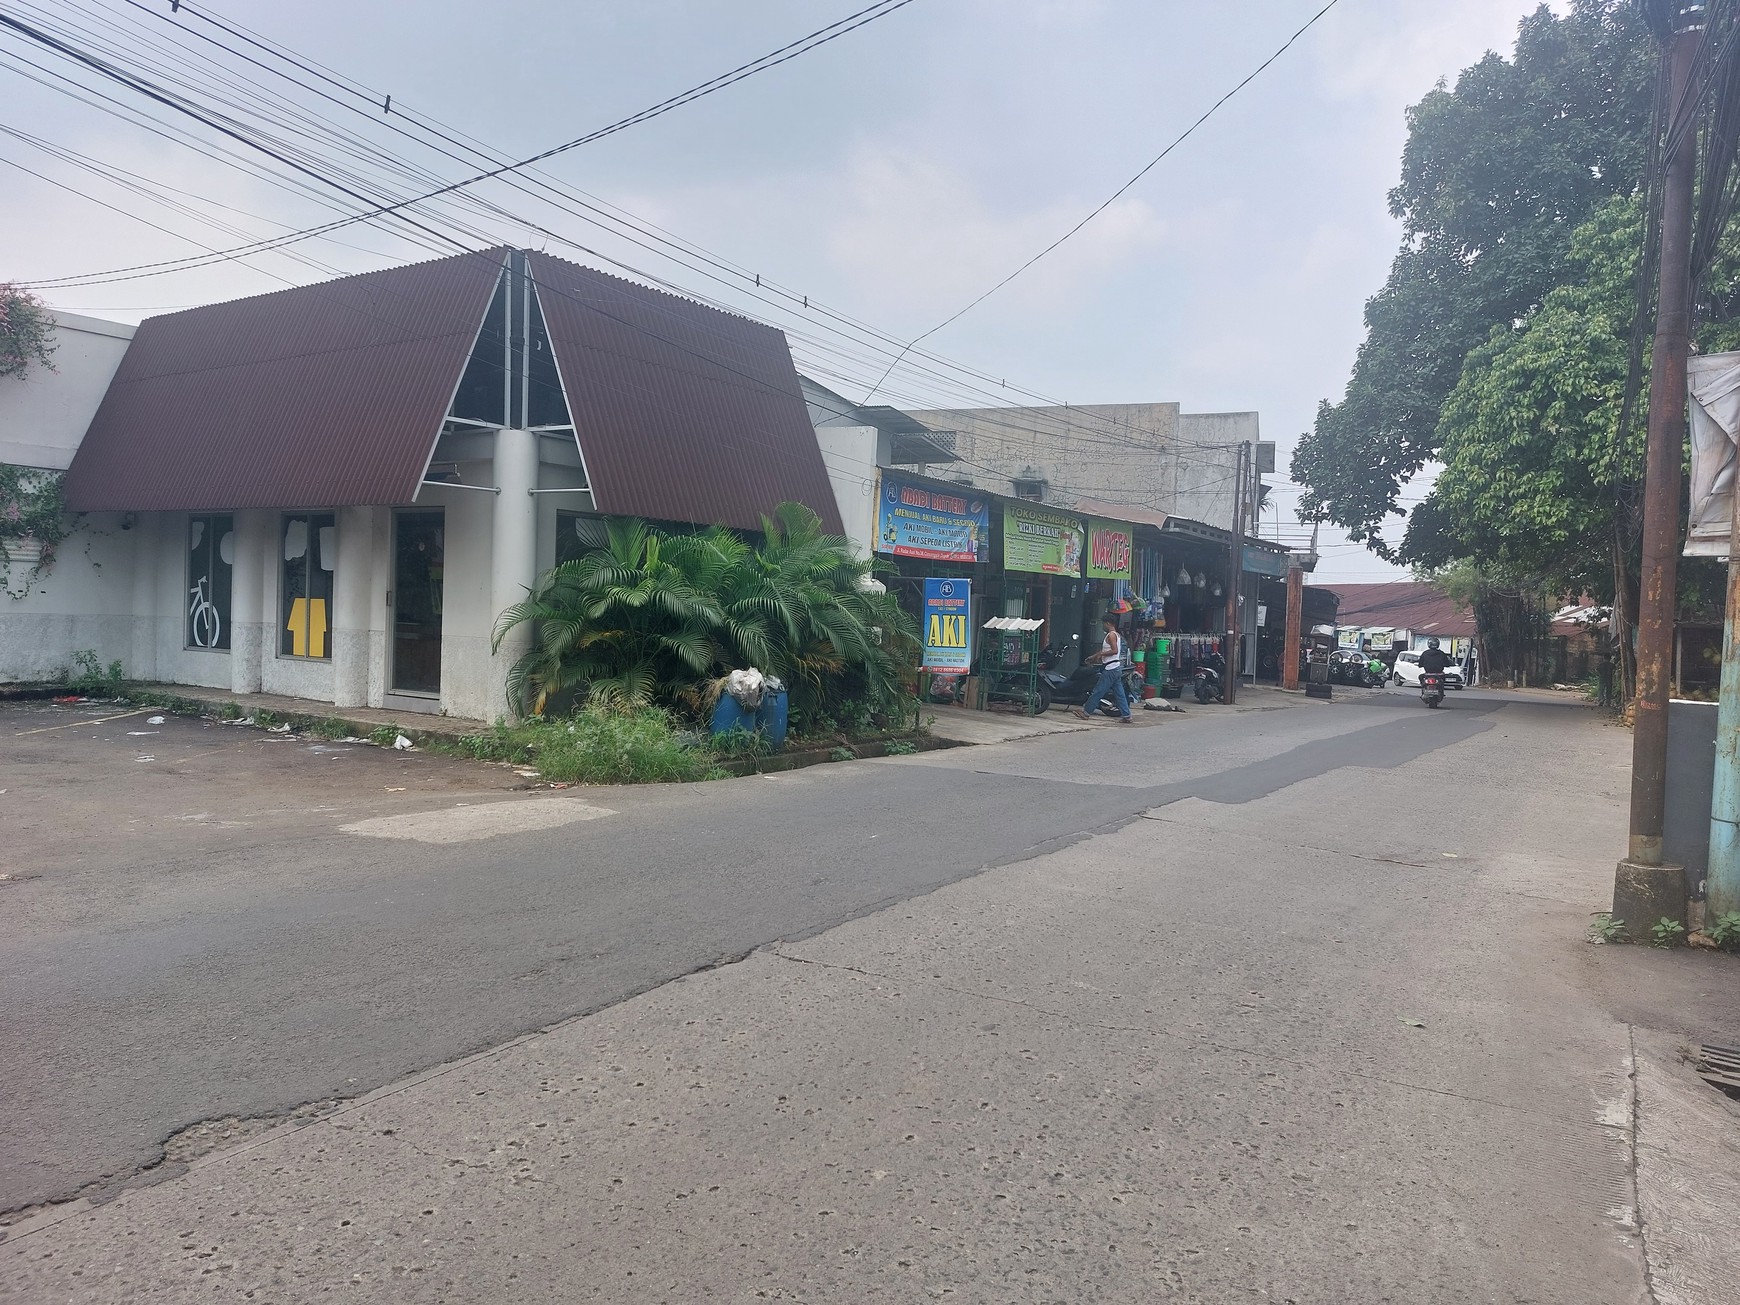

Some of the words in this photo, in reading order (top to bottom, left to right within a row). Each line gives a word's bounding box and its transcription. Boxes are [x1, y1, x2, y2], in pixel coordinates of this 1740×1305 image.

[900, 486, 930, 508] ABADI
[932, 494, 968, 515] BATTERY
[894, 508, 921, 522] MENJUAL
[922, 514, 932, 522] AKI
[932, 516, 947, 525] BARU
[953, 518, 976, 528] SECOND
[903, 522, 915, 531] AKI
[916, 524, 933, 534] MOBIL
[1010, 506, 1036, 520] TOKO
[1038, 512, 1078, 530] SEMBAKO
[908, 536, 920, 544] AKI
[920, 536, 942, 547] SEPEDA
[1091, 528, 1130, 574] WARTEG
[928, 614, 967, 647] AKI
